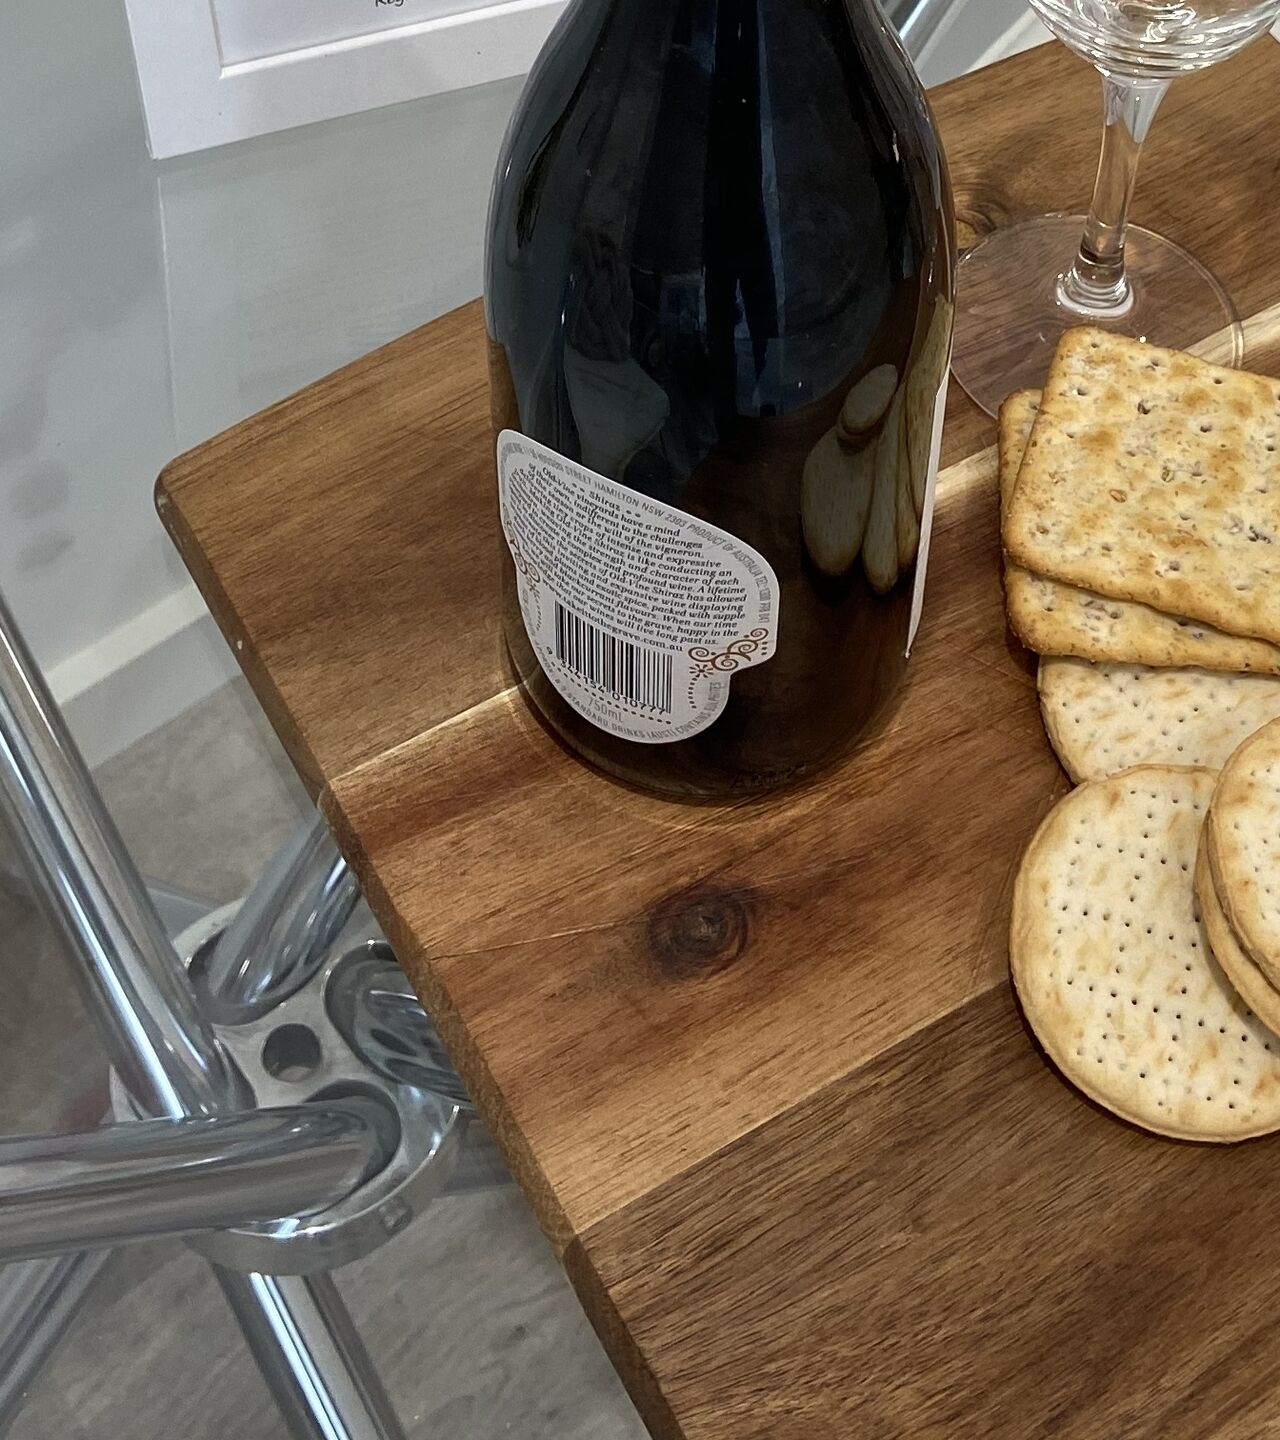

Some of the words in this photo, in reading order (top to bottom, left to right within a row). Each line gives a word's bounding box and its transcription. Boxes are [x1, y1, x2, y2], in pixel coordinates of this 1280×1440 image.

[577, 494, 619, 519] vineyards
[621, 514, 644, 528] have
[654, 527, 681, 536] mind
[588, 491, 621, 512] Shiraz
[594, 481, 640, 507] HAMILTON
[642, 502, 665, 518] NSW
[687, 524, 727, 545] PRODUCT
[574, 499, 620, 528] indifferent
[621, 524, 631, 533] to
[633, 528, 648, 538] the
[650, 534, 703, 549] challenges
[575, 512, 587, 520] or
[587, 517, 602, 529] the
[604, 527, 623, 538] will
[624, 535, 635, 544] of
[637, 538, 653, 549] the
[568, 541, 602, 564] complex
[604, 562, 621, 572] and
[622, 570, 667, 587] profound
[707, 586, 745, 595] lifetime
[573, 535, 587, 546] the
[588, 544, 626, 566] strength
[628, 563, 648, 573] and
[649, 570, 701, 583] character
[701, 576, 714, 586] of
[594, 538, 625, 558] Shiraz
[627, 552, 635, 561] is
[638, 556, 656, 567] like
[658, 563, 716, 577] conducting
[596, 532, 606, 540] of
[607, 535, 641, 554] intense
[643, 550, 664, 560] and
[666, 556, 722, 567] expressive
[578, 573, 594, 586] and
[596, 583, 623, 599] exotic
[651, 605, 687, 617] packed
[689, 611, 711, 619] with
[712, 612, 746, 621] supple
[591, 572, 608, 584] and
[610, 582, 659, 602] expansive
[661, 598, 686, 608] wine
[688, 602, 744, 612] displaying
[609, 571, 650, 591] Old-Vine
[652, 587, 685, 600] Shiraz
[686, 593, 704, 601] has
[706, 594, 747, 602] allowed
[589, 605, 614, 621] wines
[617, 618, 635, 629] will
[637, 624, 654, 635] live
[656, 630, 679, 643] long
[680, 635, 703, 644] past
[617, 609, 626, 617] to
[628, 612, 643, 623] the
[677, 625, 708, 637] happy
[663, 615, 691, 625] When
[612, 692, 665, 715] 010777
[611, 724, 646, 738] DRINKS
